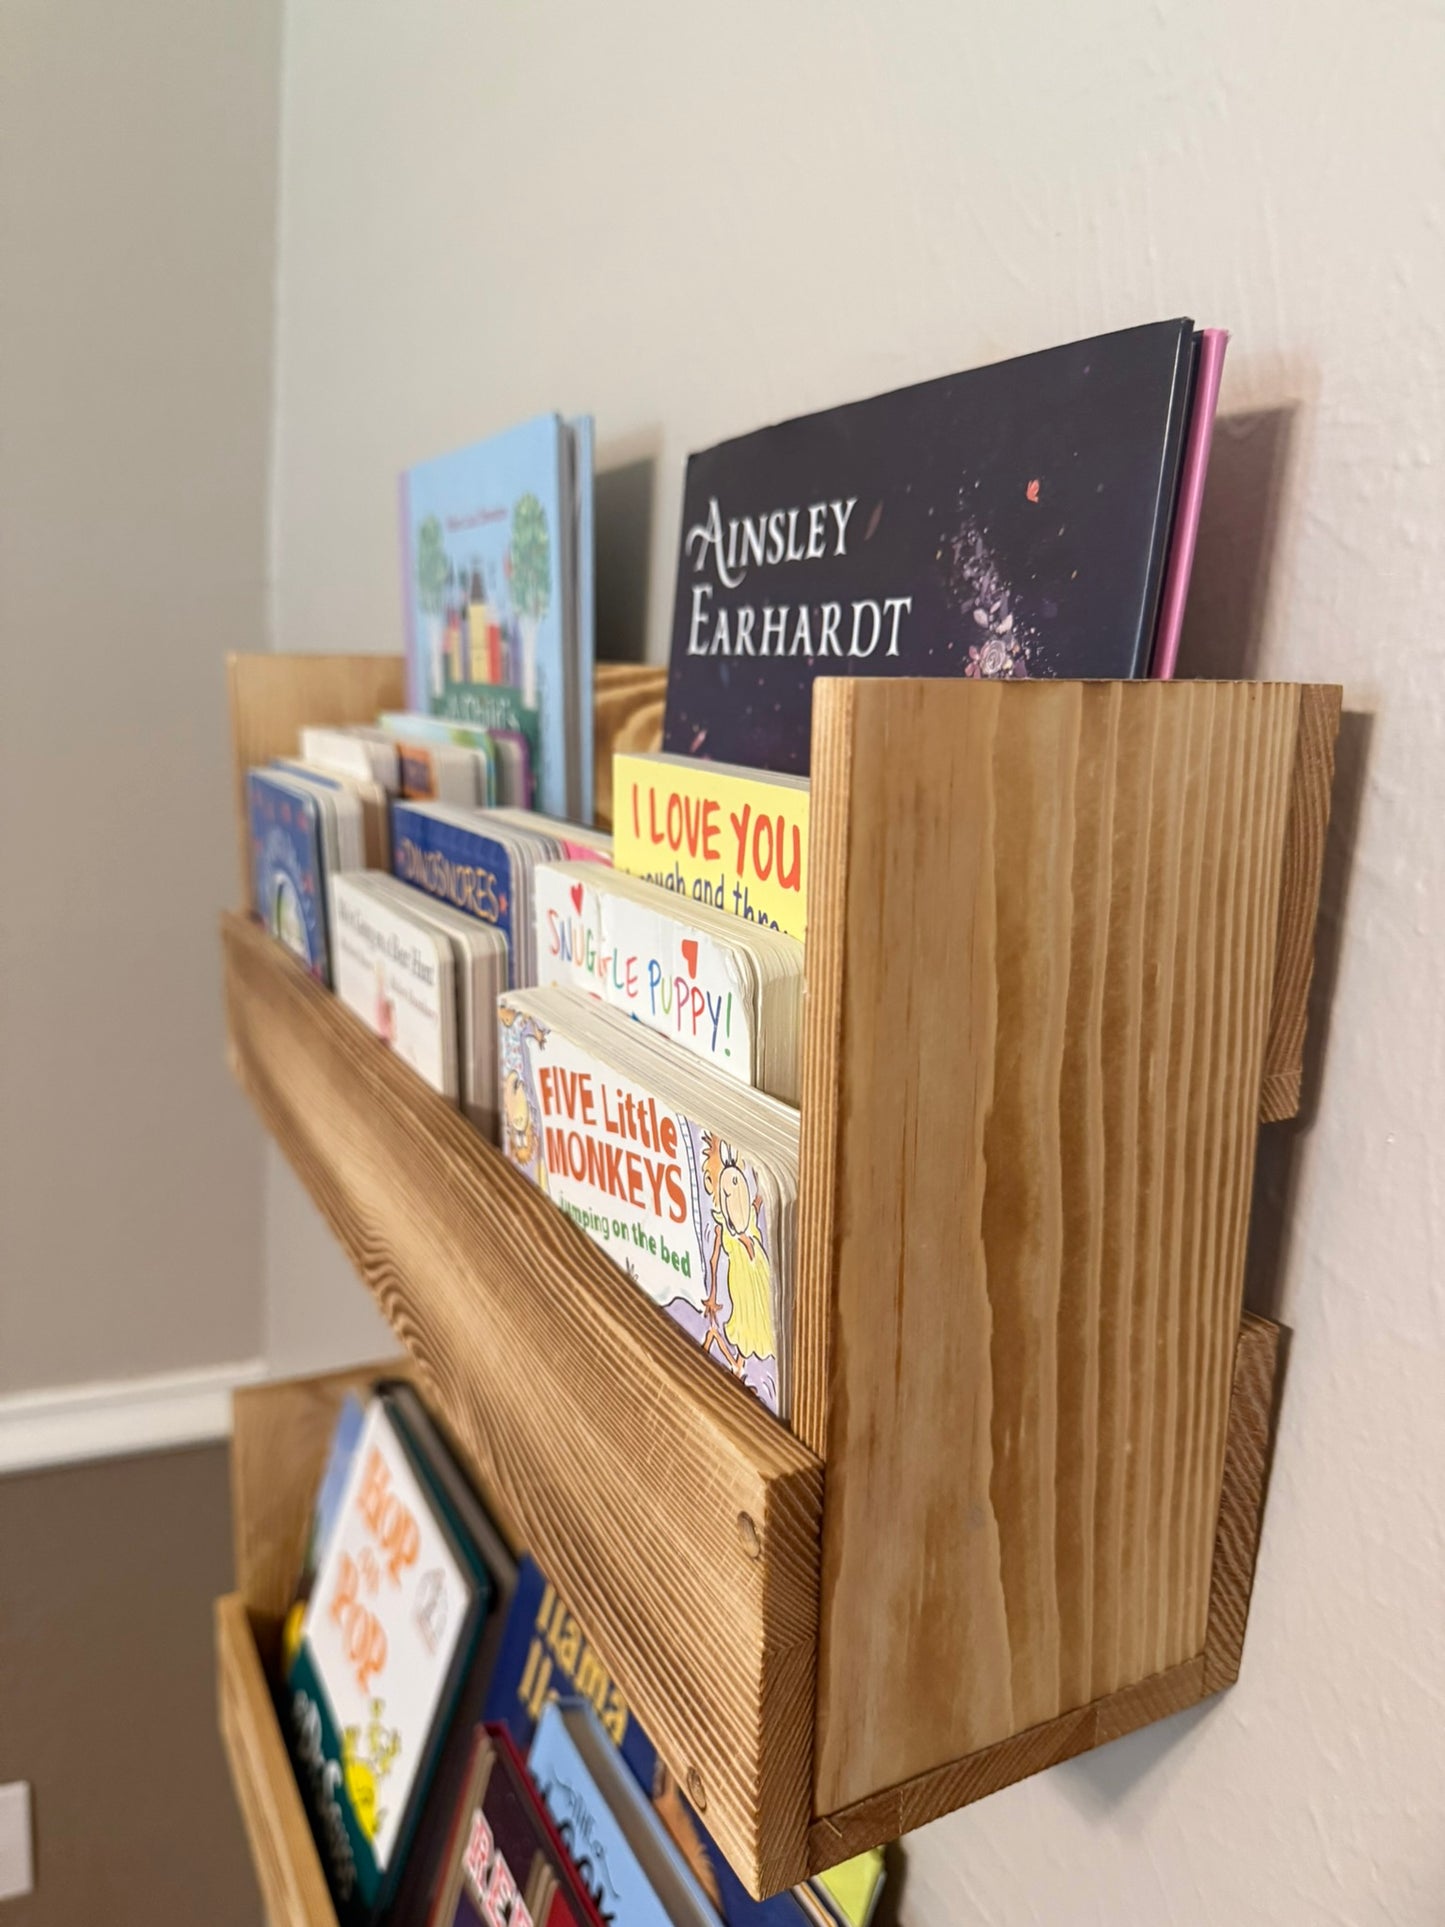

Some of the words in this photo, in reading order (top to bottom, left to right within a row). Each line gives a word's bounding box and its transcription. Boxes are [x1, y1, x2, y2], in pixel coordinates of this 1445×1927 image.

[686, 496, 857, 588] AINSLEY
[687, 583, 912, 657] EARHARDT
[633, 783, 640, 839] I
[649, 787, 721, 861] LOVE
[730, 803, 801, 892] YOU
[692, 873, 725, 910] and
[648, 959, 732, 1057] PUPPY!
[539, 1066, 596, 1126] FIVE
[601, 1083, 678, 1160] Little
[545, 1126, 687, 1224] MONKEYS
[612, 1219, 629, 1241] on
[631, 1221, 656, 1255] the
[661, 1234, 691, 1278] bed
